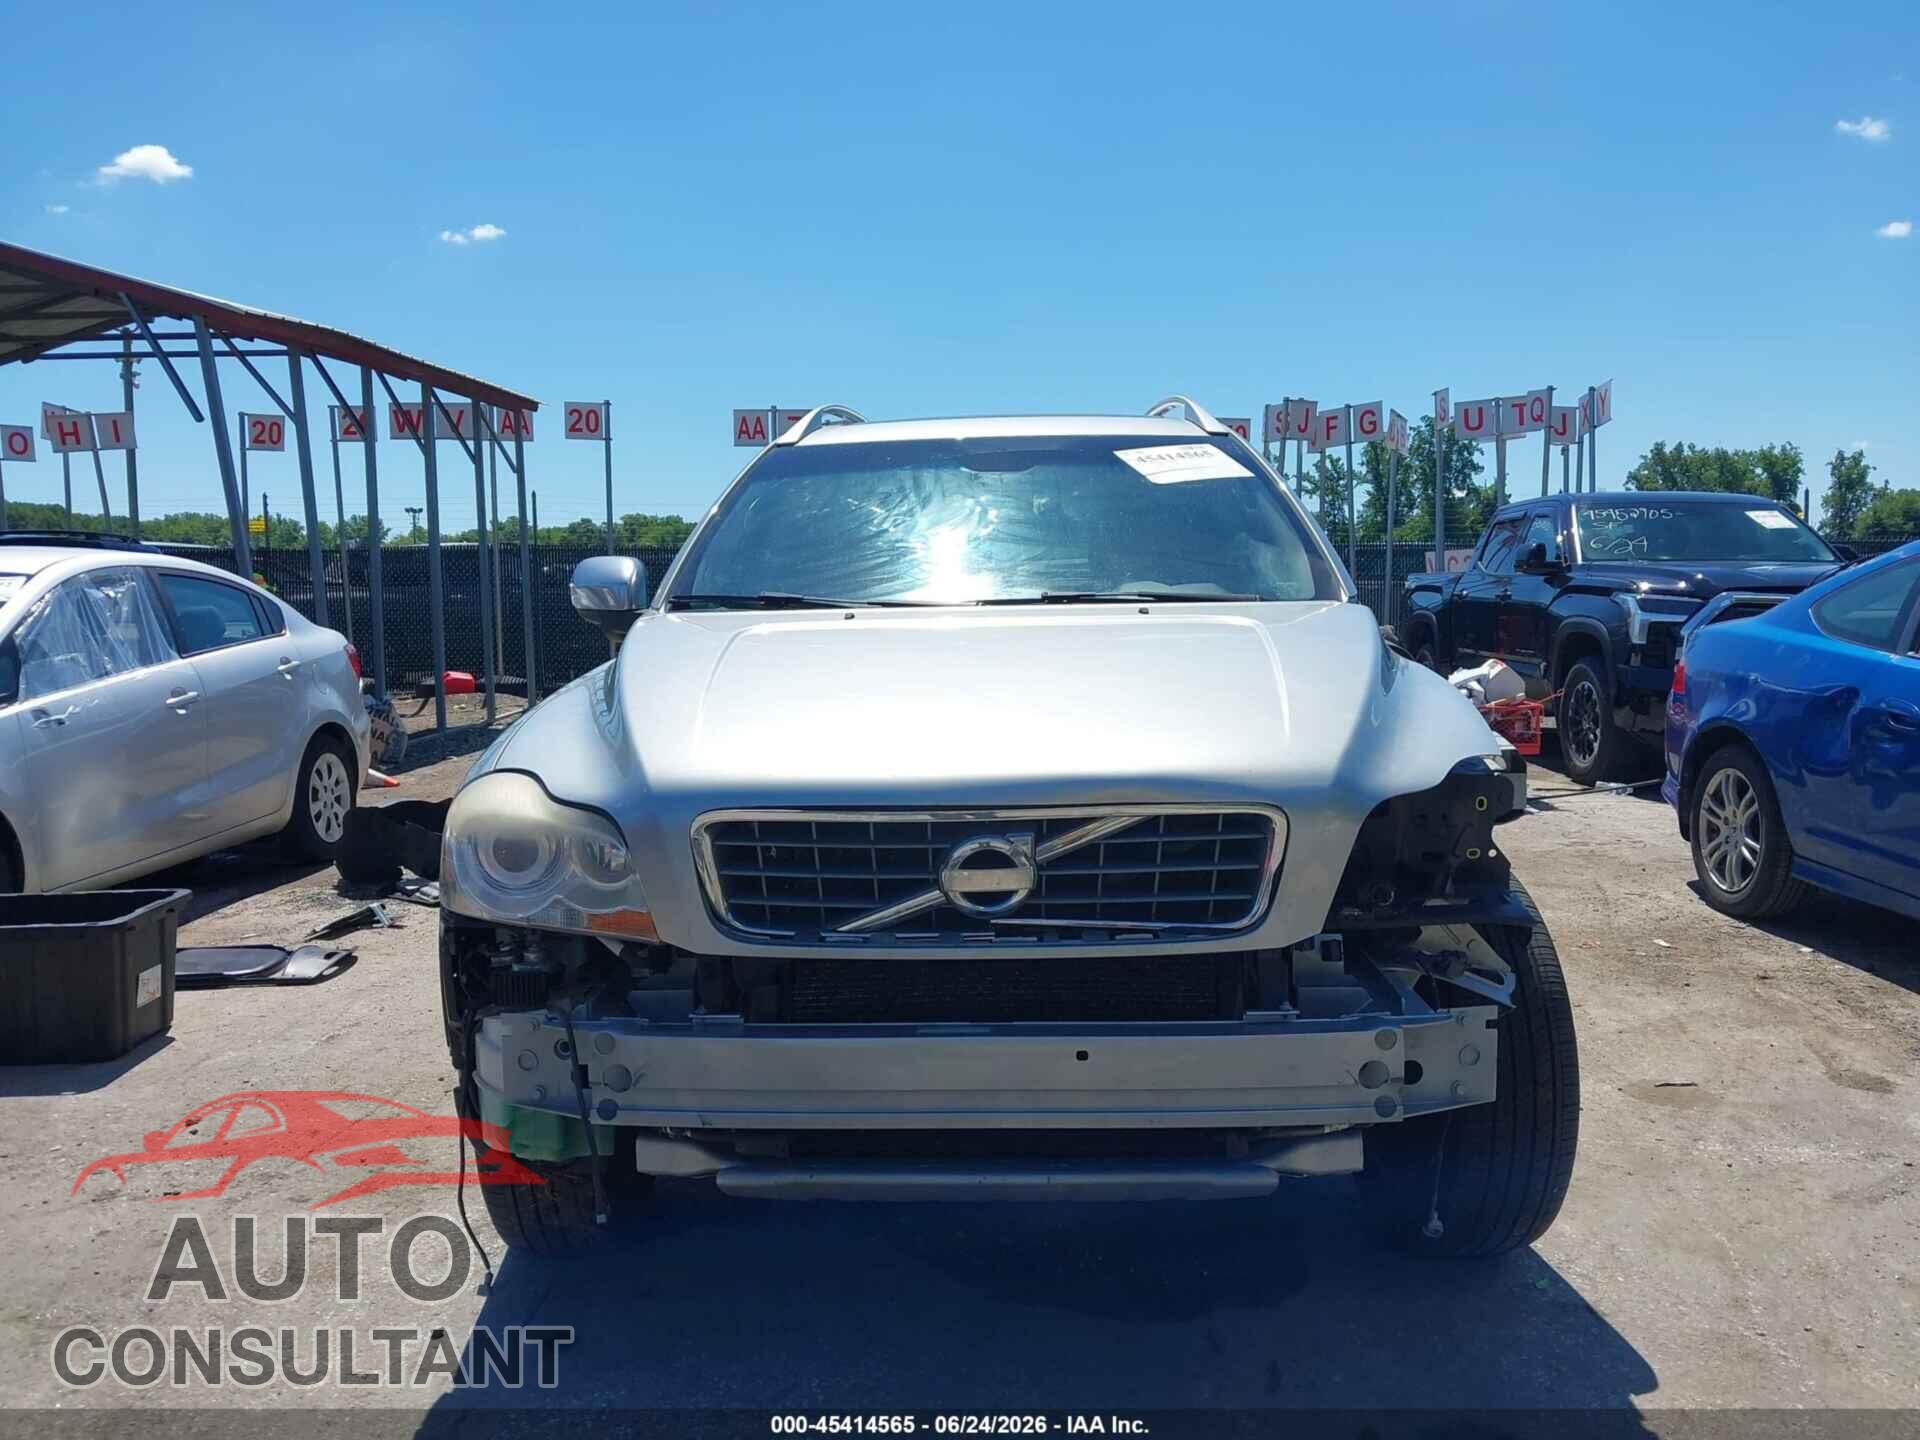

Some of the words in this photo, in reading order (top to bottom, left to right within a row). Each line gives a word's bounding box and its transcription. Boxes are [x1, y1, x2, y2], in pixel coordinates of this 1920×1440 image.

[567, 408, 599, 433] 20
[1297, 407, 1310, 433] J
[1359, 409, 1377, 434] G
[1463, 406, 1484, 431] U
[1511, 402, 1527, 426] T
[1530, 397, 1545, 423] Q
[57, 420, 81, 446] H
[251, 420, 282, 444] 20
[737, 416, 766, 440] AA
[1325, 415, 1339, 441] F
[1552, 412, 1567, 436] J
